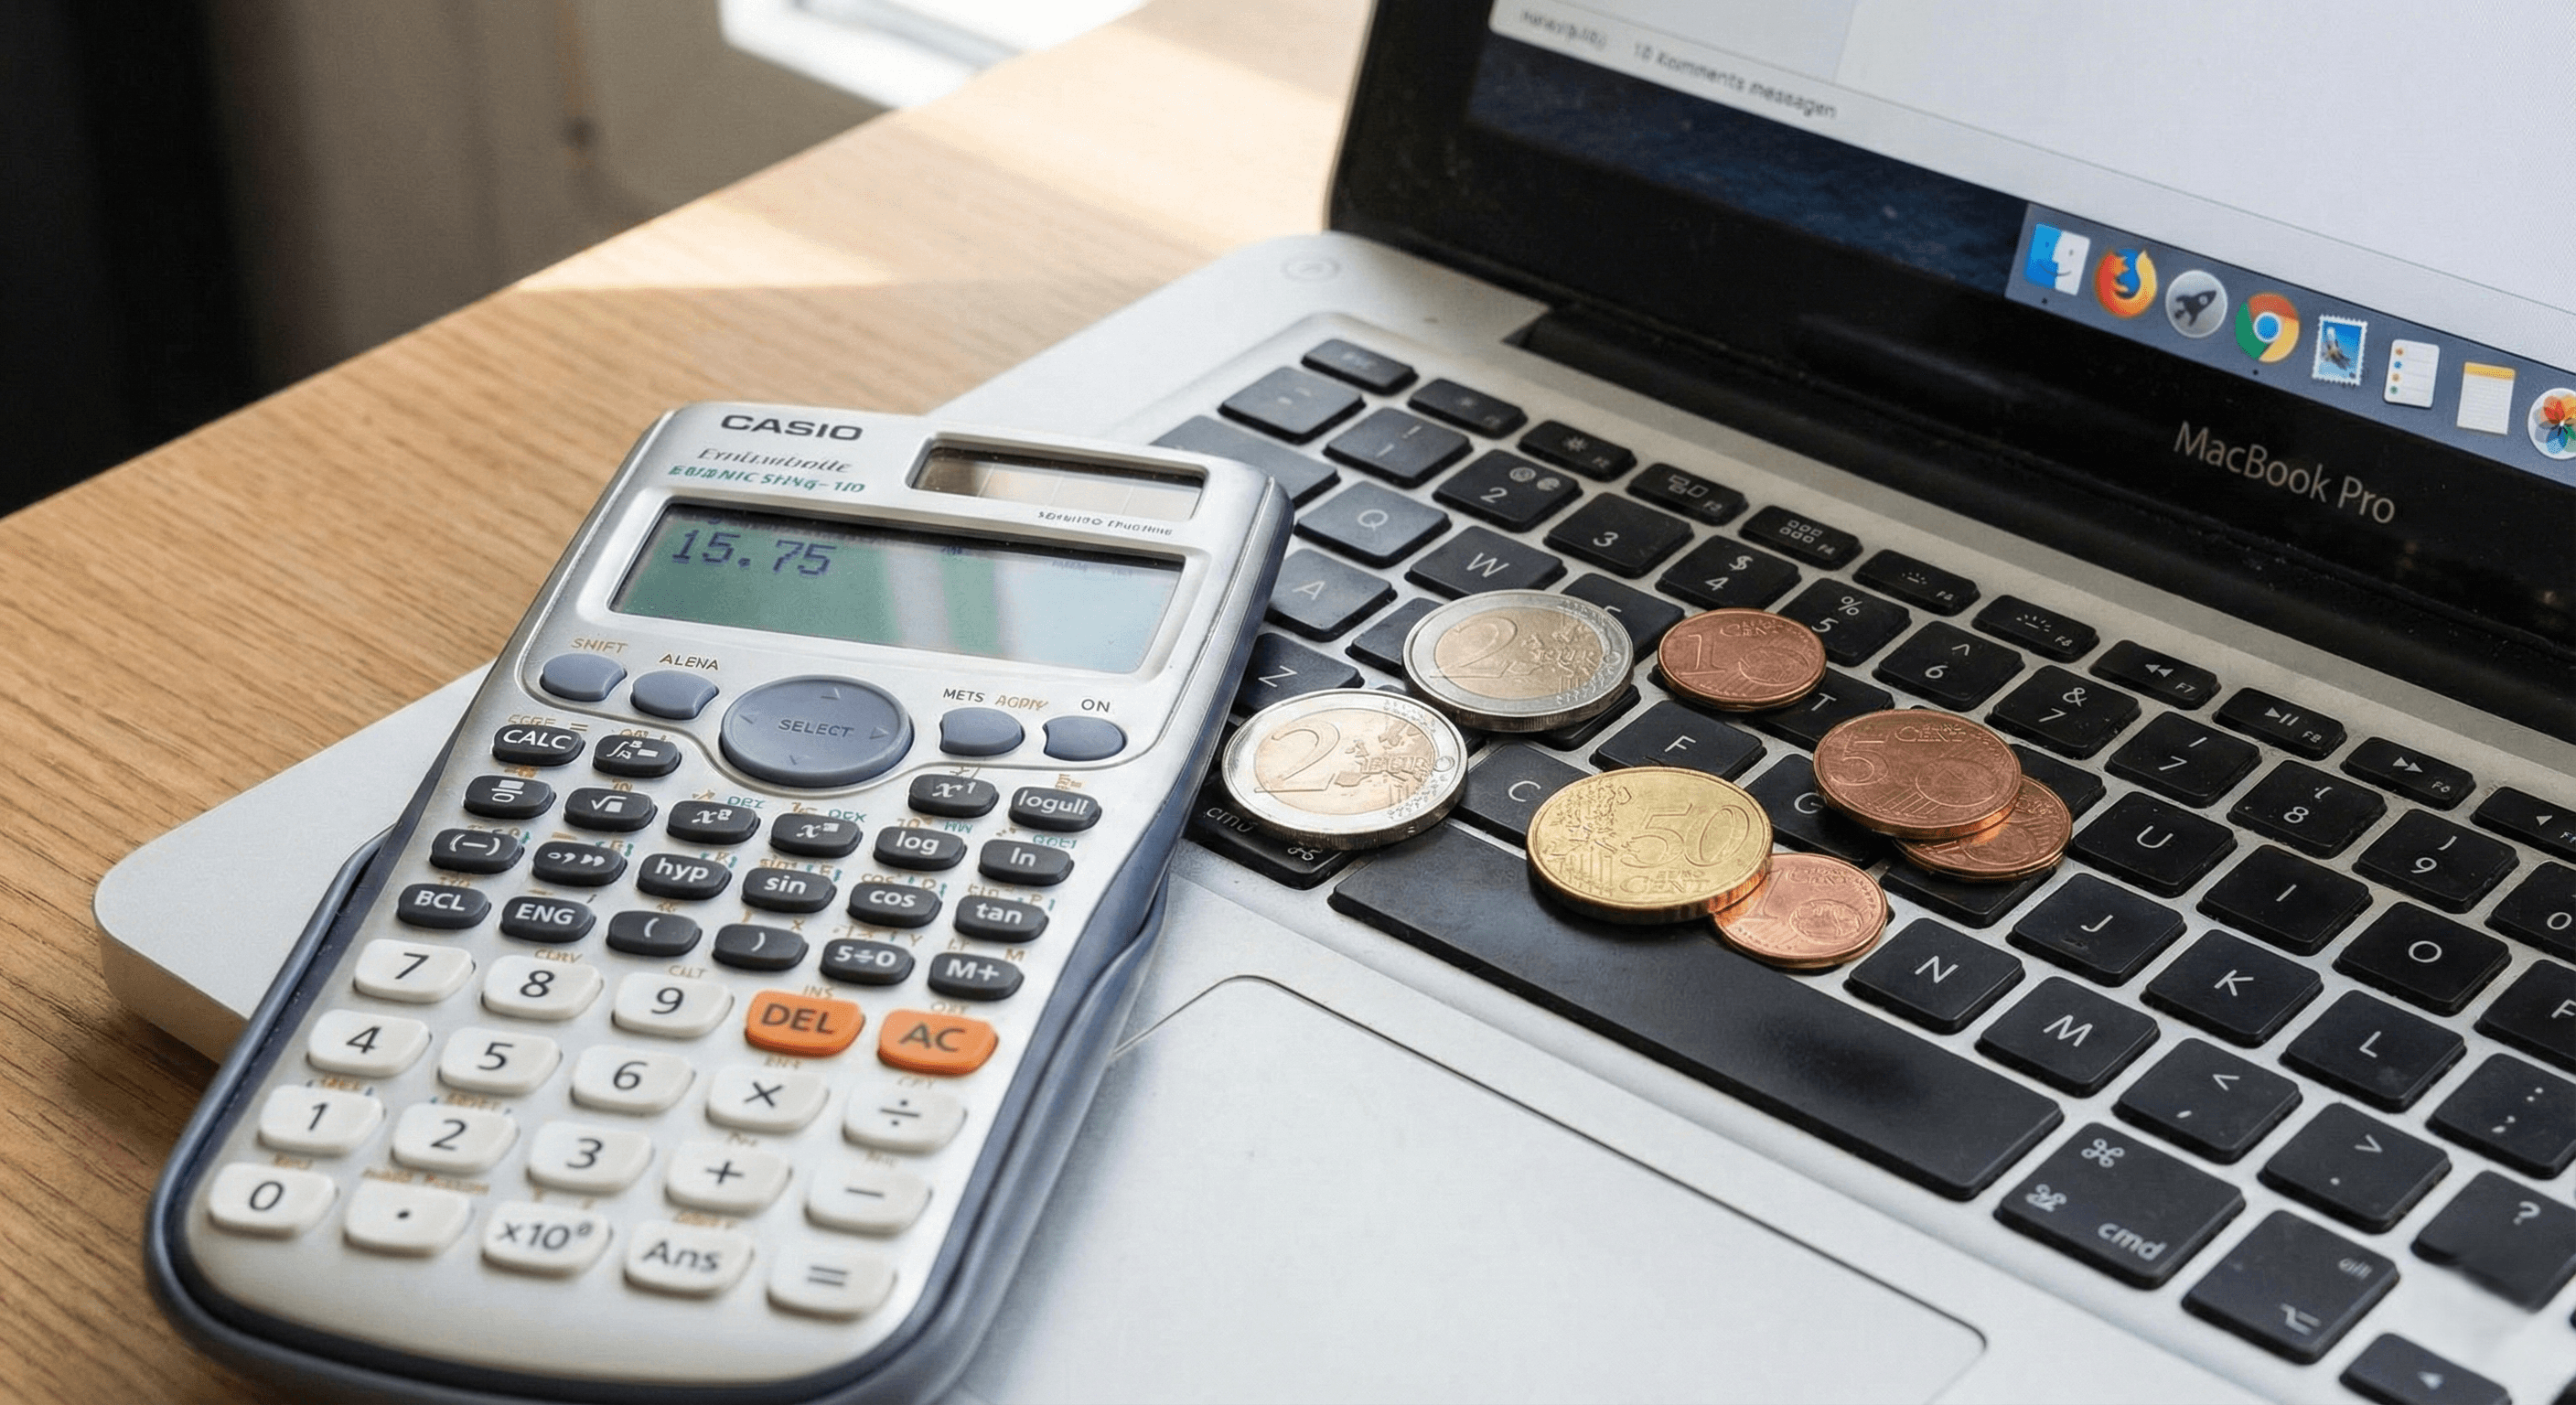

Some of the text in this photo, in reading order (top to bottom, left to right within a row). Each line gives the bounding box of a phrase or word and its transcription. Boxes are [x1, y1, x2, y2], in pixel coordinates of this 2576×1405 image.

[721, 414, 864, 441] CASIO
[2174, 421, 2396, 524] MacBook Pro
[1481, 488, 1508, 502] 2
[1358, 509, 1389, 532] Q
[1594, 532, 1619, 547] 3
[672, 529, 837, 575] 15.75
[1466, 552, 1508, 578] W
[1292, 580, 1326, 601] A
[1705, 576, 1729, 591] 4
[1838, 596, 1862, 616] %
[1812, 617, 1839, 633] 5
[1429, 616, 1519, 679] 2
[1680, 634, 1728, 677] 1
[660, 653, 719, 670] ALENA
[1926, 665, 1948, 679] 6
[1258, 665, 1297, 687] Z
[943, 689, 985, 702] METS
[1081, 699, 1111, 713] ON
[1811, 692, 1837, 711] T
[2063, 688, 2088, 707] &
[2038, 708, 2066, 723] 7
[503, 729, 573, 750] CALC
[778, 719, 853, 739] SELECT
[1254, 719, 1340, 793] 2
[1665, 735, 1696, 753] F
[1830, 732, 1890, 787] 5
[2159, 756, 2187, 771] 7
[1508, 780, 1540, 802] C
[1794, 792, 1823, 814] G
[2283, 806, 2309, 823] 8
[896, 831, 939, 855] log
[1620, 802, 1750, 867] 50
[2136, 825, 2174, 849] U
[655, 858, 710, 883] hyp
[2411, 857, 2438, 874] 9
[765, 874, 808, 896] sin
[414, 890, 465, 910] BCL
[869, 890, 917, 908] cos
[515, 903, 574, 926] ENG
[976, 902, 1023, 925] tan
[2081, 915, 2113, 933] J
[395, 952, 430, 980] 7
[946, 960, 999, 981] M+
[1915, 955, 1959, 983] N
[520, 970, 555, 998] 8
[2214, 970, 2254, 996] K
[650, 987, 684, 1014] 9
[761, 1003, 836, 1035] DEL
[2044, 1014, 2093, 1046] M
[346, 1025, 382, 1054] 4
[898, 1023, 967, 1052] AC
[2359, 1031, 2381, 1058] L
[477, 1042, 515, 1070] 5
[613, 1060, 649, 1090] 6
[308, 1102, 328, 1131] 1
[430, 1119, 467, 1151] 2
[565, 1138, 604, 1169] 3
[249, 1181, 284, 1212] 0
[2513, 1201, 2541, 1226] ?
[2098, 1223, 2168, 1261] cmd
[642, 1238, 720, 1271] Ans
